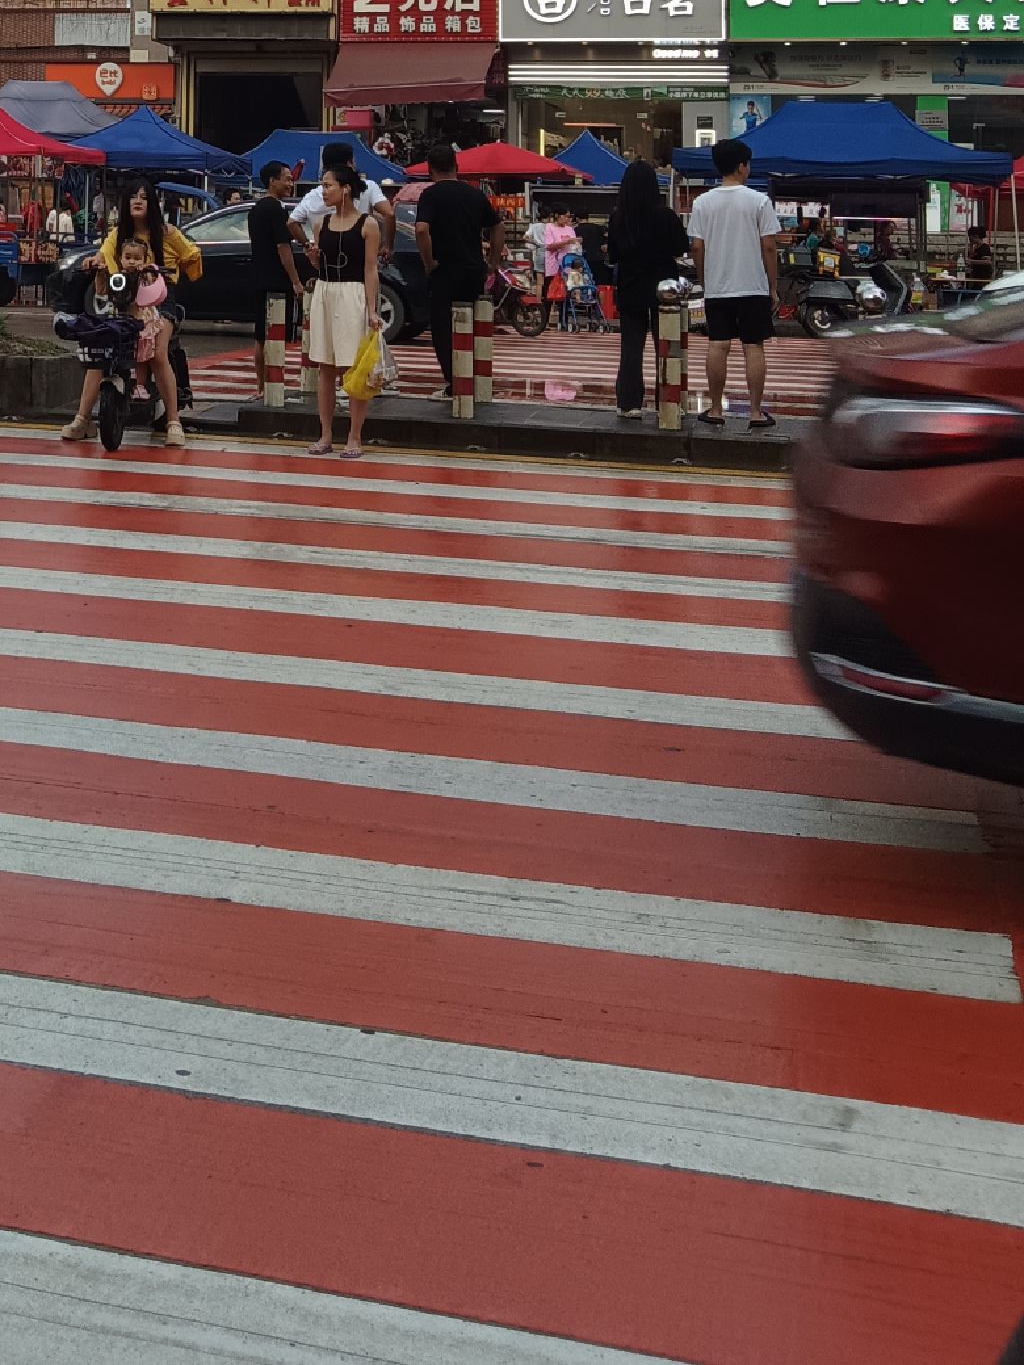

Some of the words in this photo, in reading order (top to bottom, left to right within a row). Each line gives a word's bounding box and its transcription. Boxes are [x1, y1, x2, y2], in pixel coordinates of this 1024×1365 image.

[353, 15, 391, 34] 精品
[399, 15, 437, 34] 饰品
[444, 15, 482, 34] 箱包
